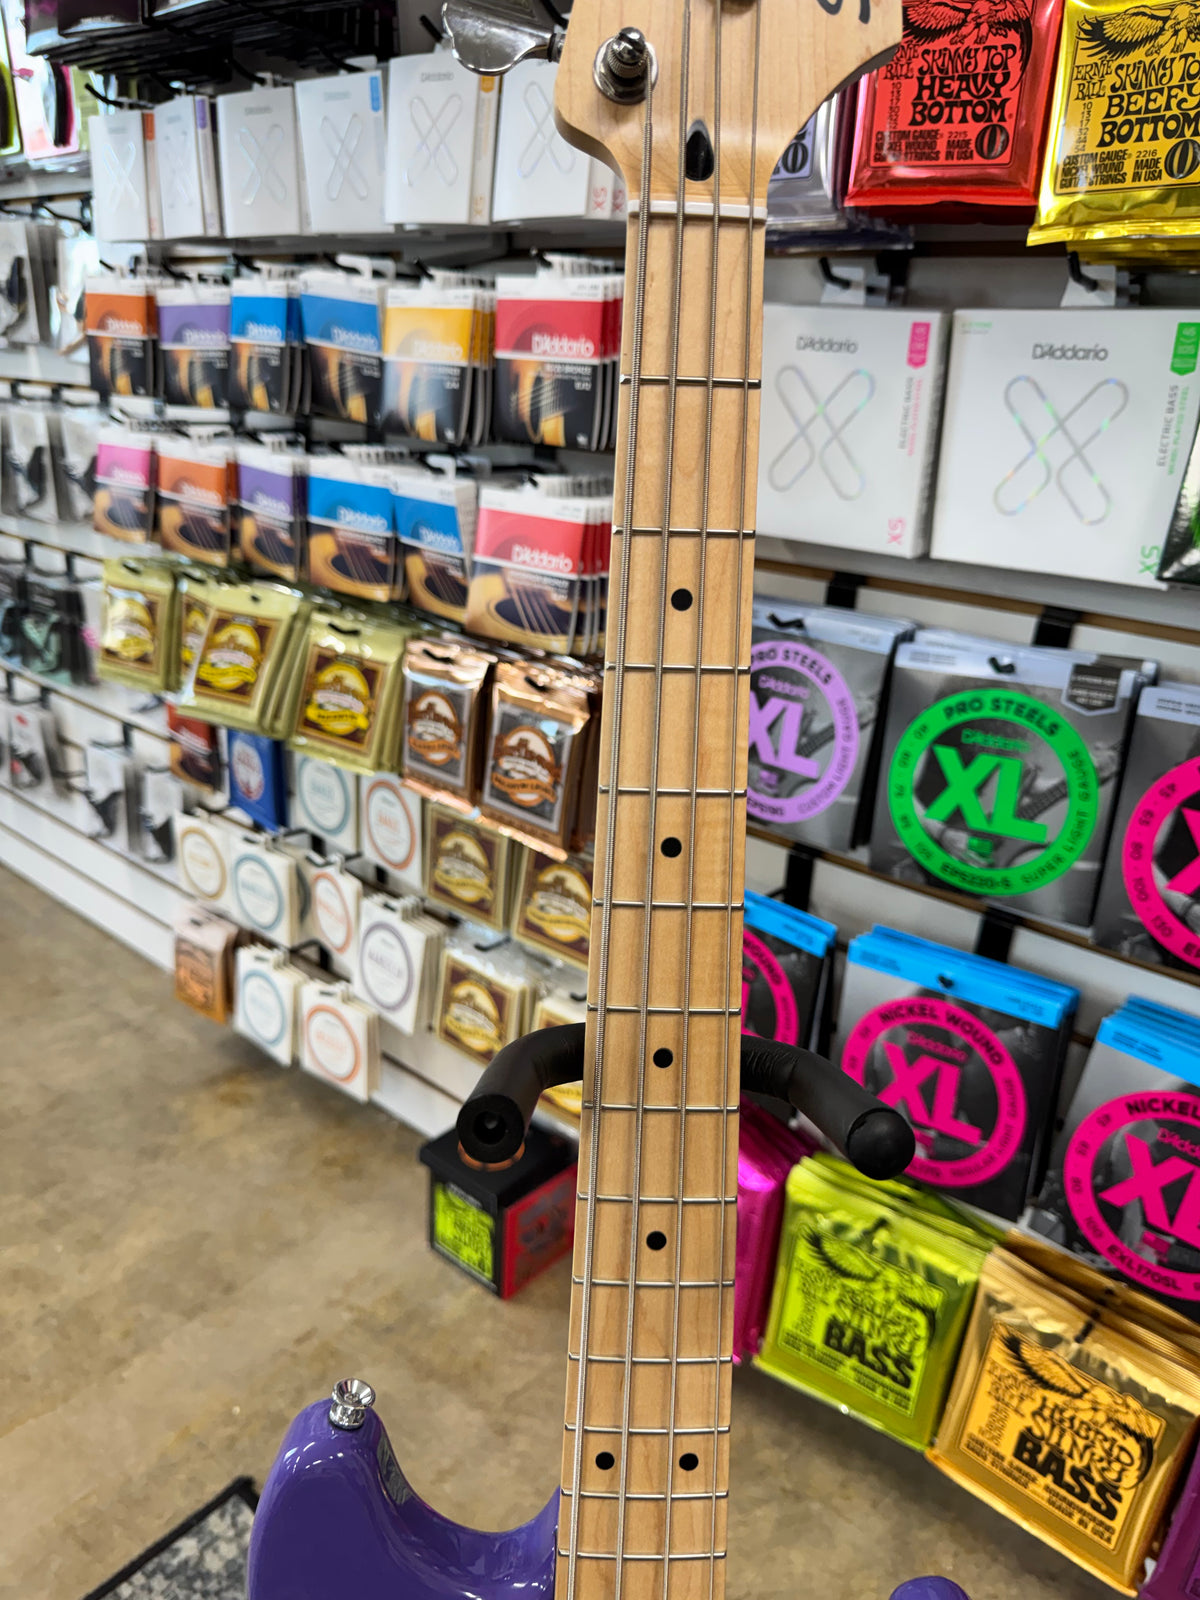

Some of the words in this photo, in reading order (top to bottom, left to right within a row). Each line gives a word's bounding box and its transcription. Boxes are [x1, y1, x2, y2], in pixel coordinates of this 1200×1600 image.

[892, 42, 921, 62] RNIE
[918, 47, 980, 76] SKINNY
[983, 43, 1017, 72] TOP
[884, 62, 914, 80] BALL
[1074, 58, 1115, 81] ERNIE
[1110, 56, 1177, 93] SKINNY
[1179, 52, 1200, 83] TO
[914, 71, 1011, 101] HEAVY
[1074, 80, 1106, 101] BALL
[908, 98, 1012, 126] BOTTOM
[1083, 102, 1093, 110] 10
[1102, 82, 1200, 120] BEEFY
[913, 129, 940, 140] GAUGE
[1096, 111, 1200, 148] BOTTOM
[905, 141, 937, 150] WOUND
[945, 150, 955, 161] IN
[957, 150, 974, 160] USA
[946, 139, 972, 149] MADE
[1136, 149, 1158, 158] 2216
[1063, 152, 1098, 166] CUSTOM
[1098, 149, 1128, 162] GAUGE
[1092, 162, 1124, 174] WOUND
[1134, 158, 1161, 170] MADE
[1089, 172, 1127, 186] STRINGS
[1132, 170, 1141, 182] IN
[1144, 169, 1162, 181] USA
[1165, 384, 1179, 414] BASS
[782, 649, 832, 685] STEELS
[943, 698, 983, 720] PRO
[990, 698, 1060, 737] STEELS
[923, 744, 1048, 843] XL
[879, 1003, 939, 1025] NICKEL
[945, 1009, 1004, 1066] WOUND
[876, 1041, 982, 1145] XL
[824, 1314, 915, 1389] BASS
[1013, 1425, 1123, 1522] BASS
